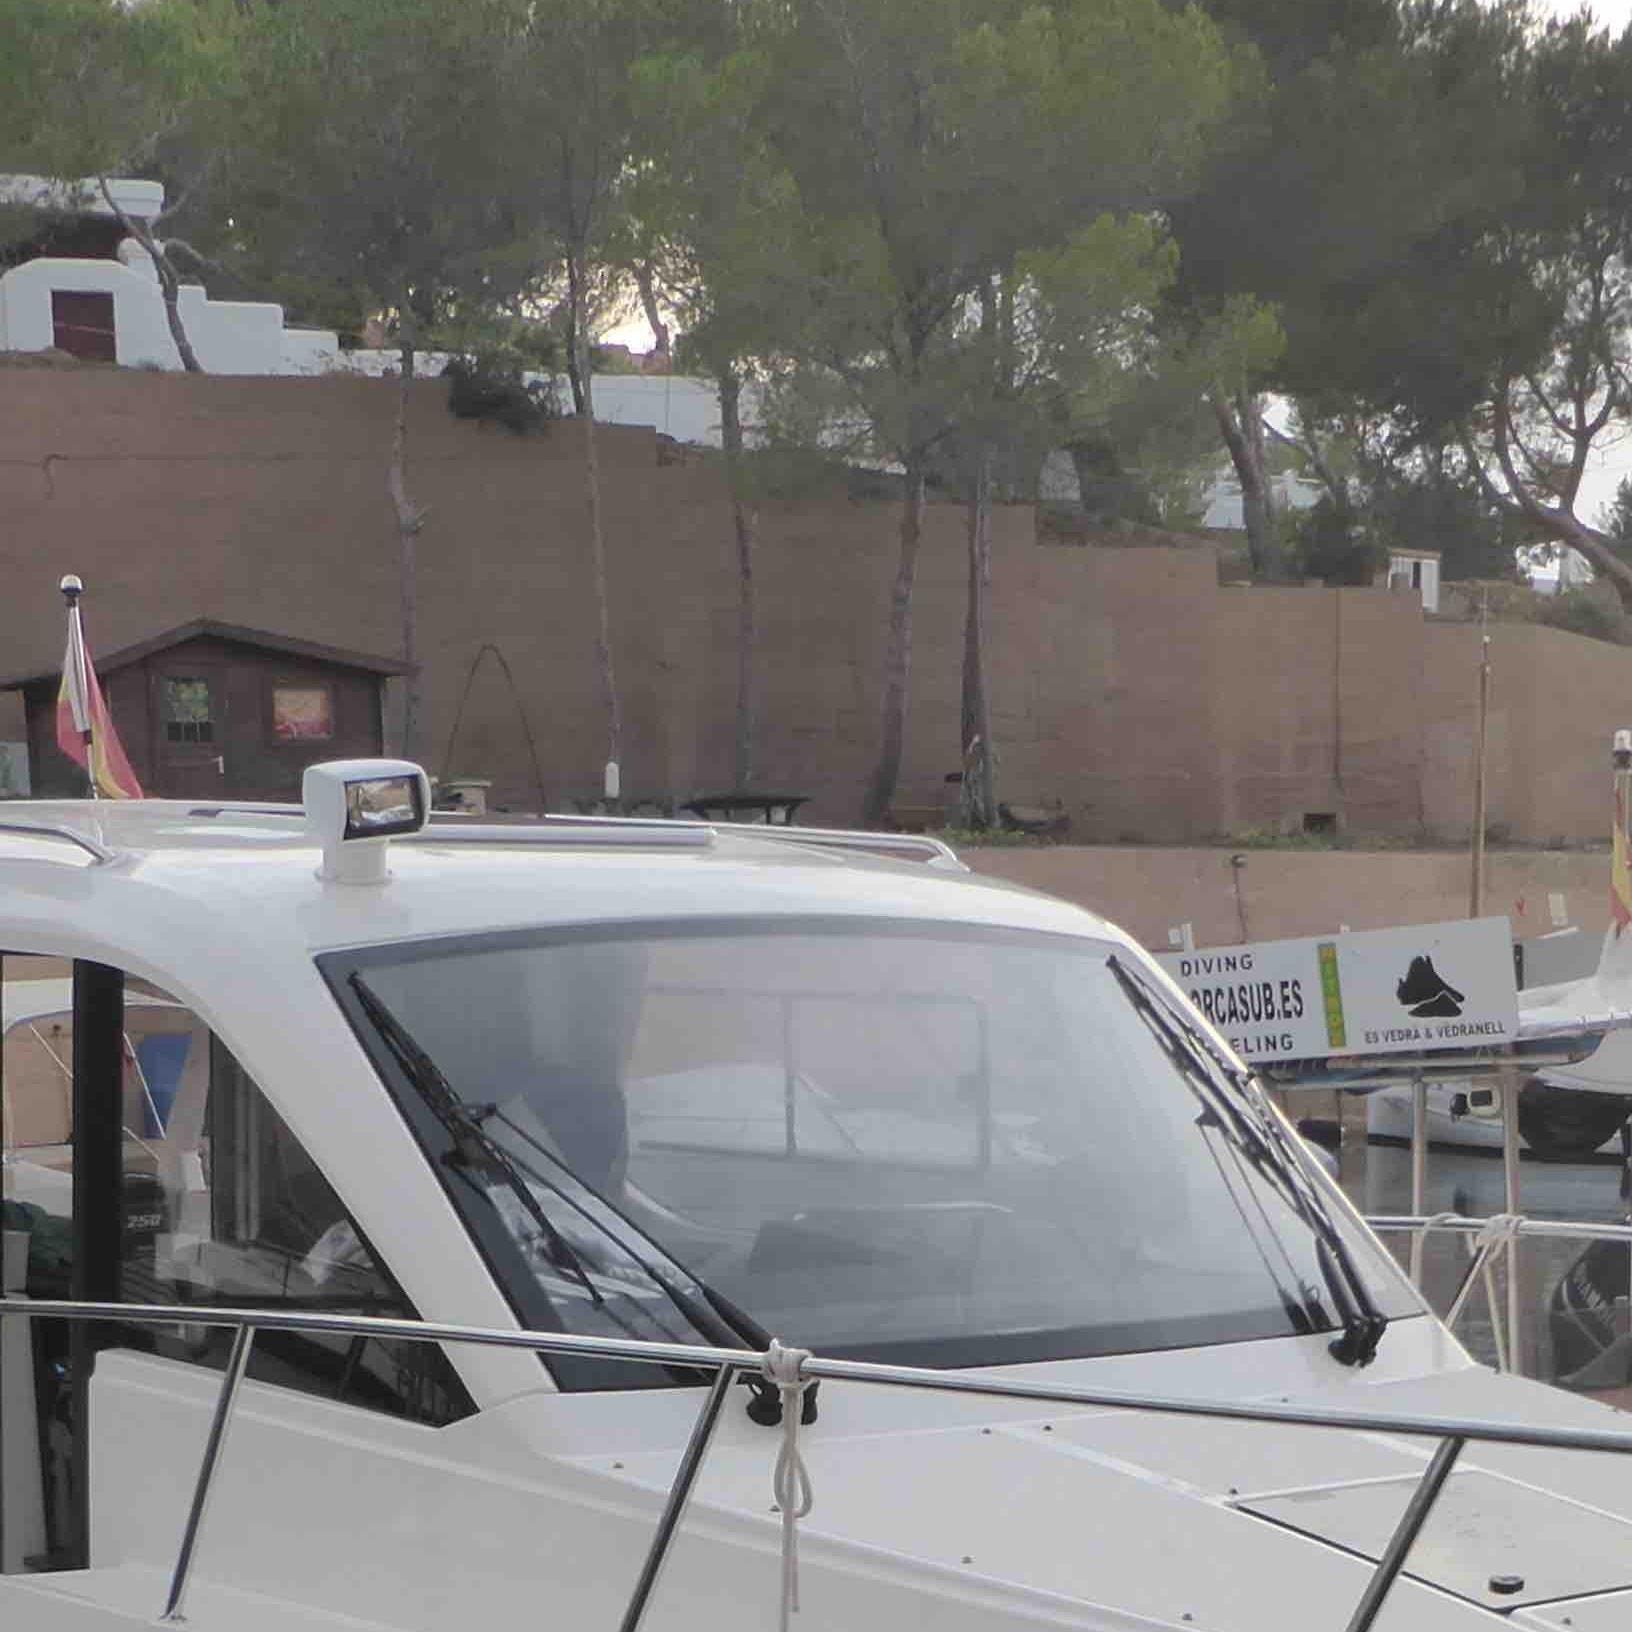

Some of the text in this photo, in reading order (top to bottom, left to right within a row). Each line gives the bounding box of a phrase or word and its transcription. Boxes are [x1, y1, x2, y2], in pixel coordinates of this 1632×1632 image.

[1180, 954, 1254, 977] DIVING
[1383, 1028, 1421, 1043] VEDRA
[1437, 1019, 1505, 1038] VEDRANELL
[1230, 1033, 1294, 1053] ELING
